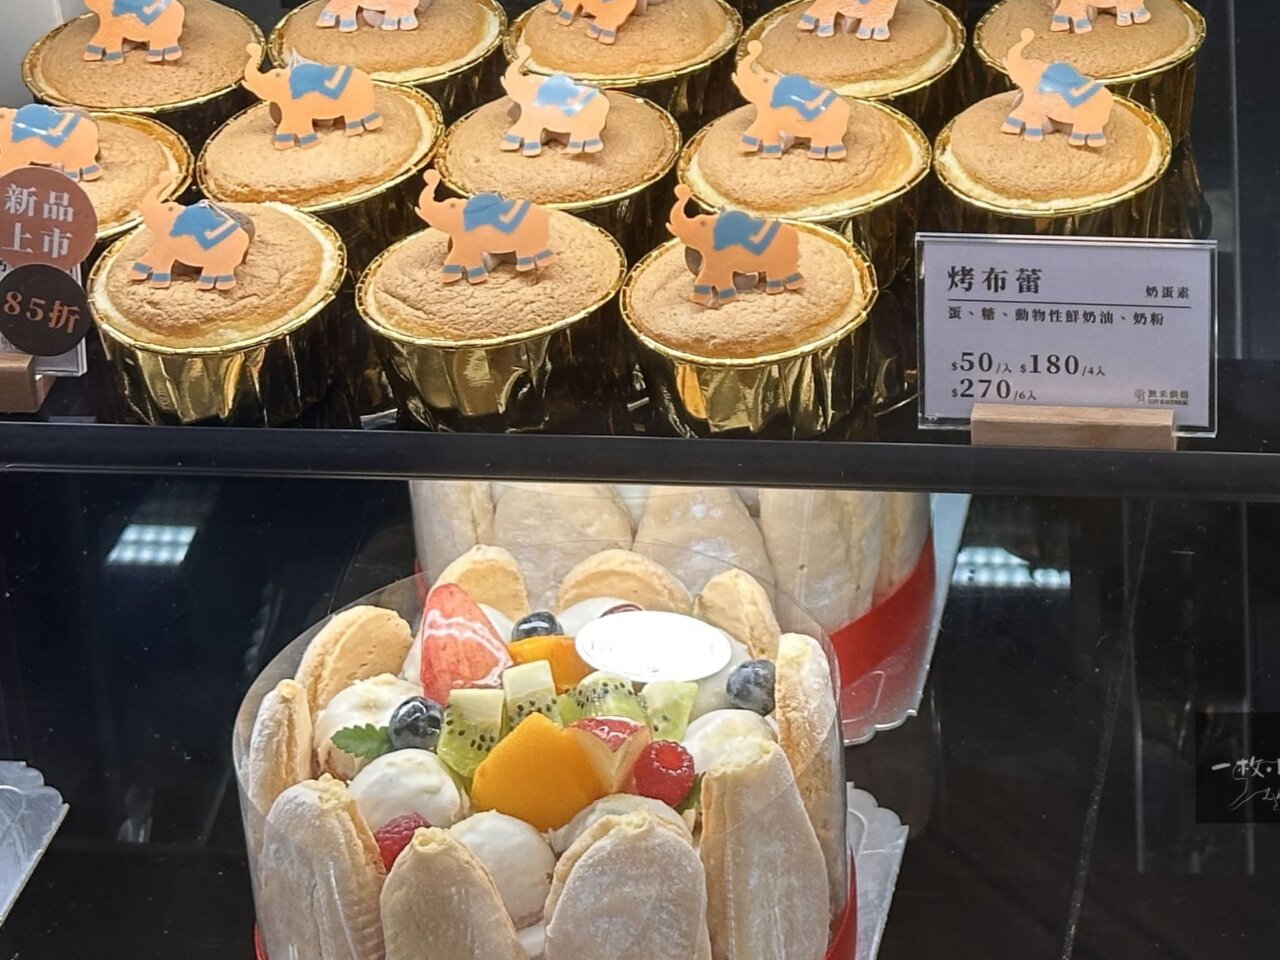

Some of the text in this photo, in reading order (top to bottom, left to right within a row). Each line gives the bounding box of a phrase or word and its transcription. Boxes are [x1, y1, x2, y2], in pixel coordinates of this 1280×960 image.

[4, 183, 75, 222] 新品
[2, 222, 73, 258] 上市
[947, 266, 1043, 294] 烤布蕾
[1145, 285, 1190, 300] 奶蛋素
[3, 291, 81, 333] 85折
[947, 306, 1164, 326] 蛋、糖、動物性鮮奶油、奶粉
[951, 352, 1106, 377] $50/入 $180/4入
[951, 378, 1037, 401] $270/6入
